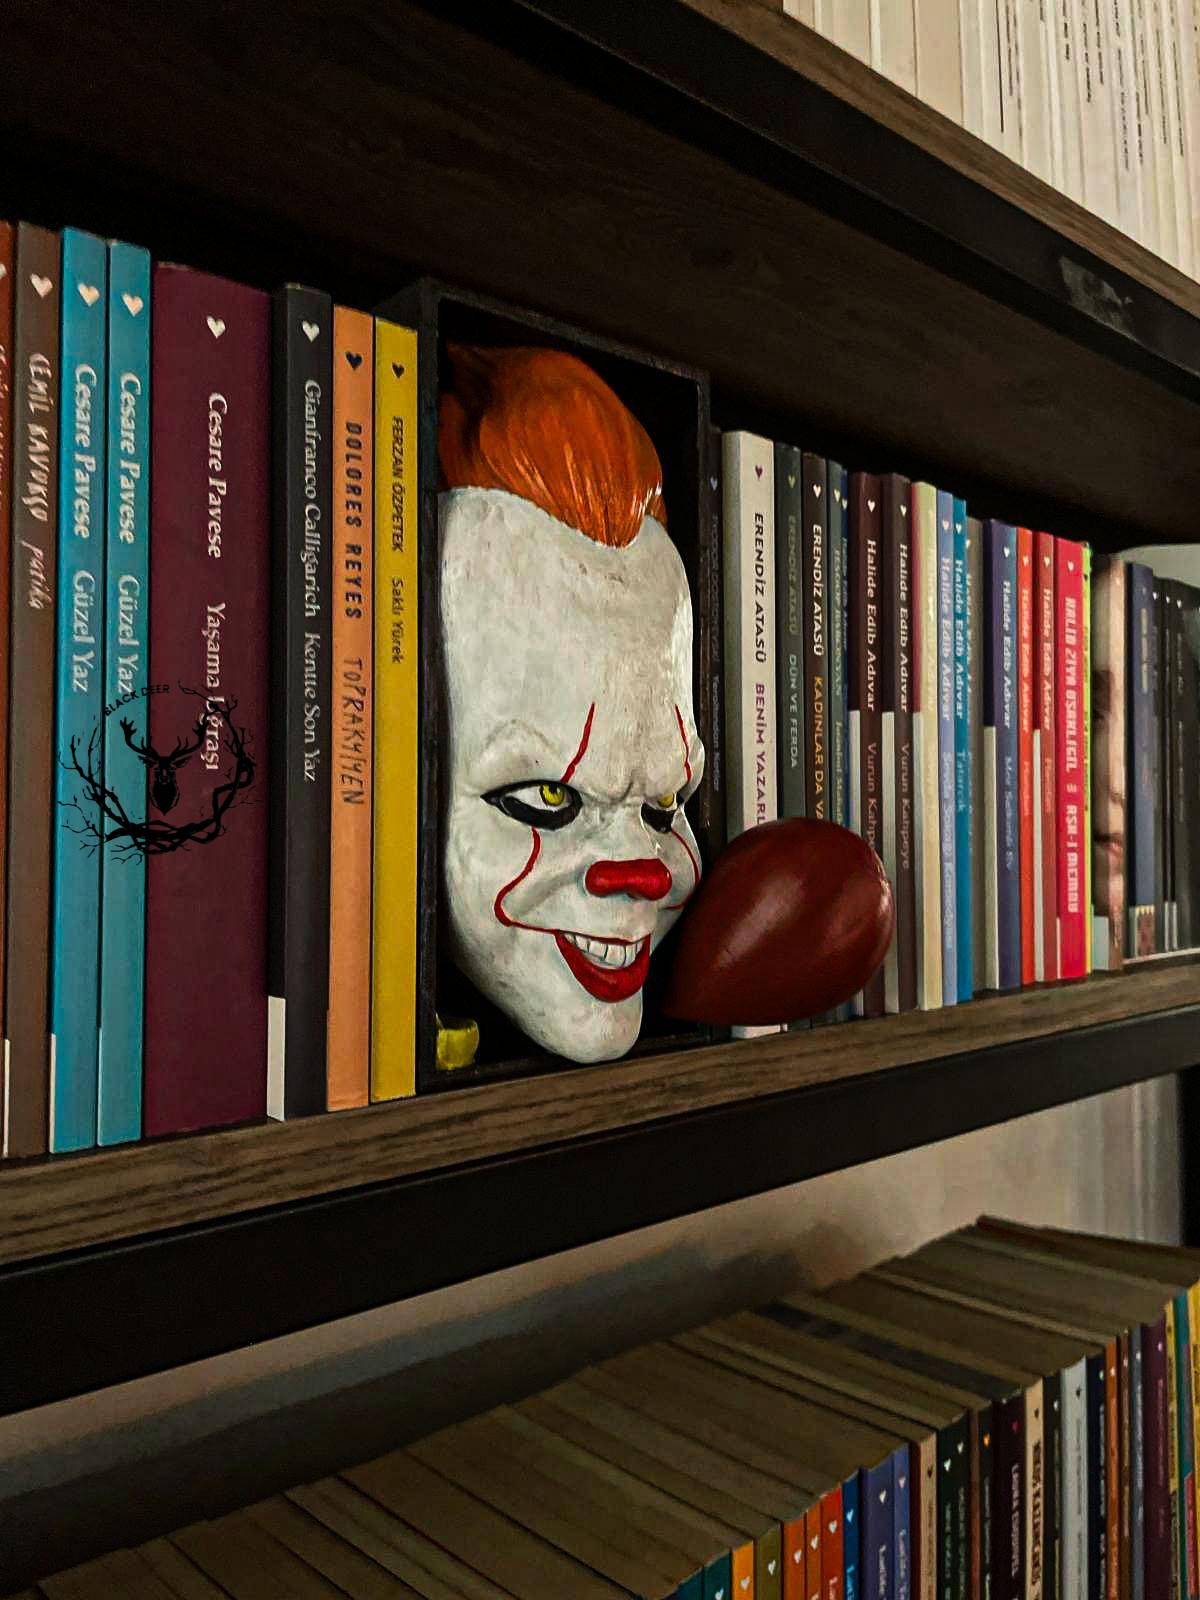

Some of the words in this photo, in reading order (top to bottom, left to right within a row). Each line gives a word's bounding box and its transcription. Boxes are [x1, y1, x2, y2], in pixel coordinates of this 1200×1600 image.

[27, 353, 55, 417] CEMİL
[74, 364, 98, 447] Cesare
[119, 372, 142, 454] Cesare
[207, 392, 229, 471] Cesare
[302, 379, 322, 499] Gianfranco
[392, 416, 405, 477] FERZAN
[20, 423, 52, 523] KAVUKÇU
[74, 452, 98, 539] Pavese
[119, 459, 142, 545] Pavese
[345, 421, 363, 527] DOLORES
[207, 475, 228, 559] Pavese
[392, 482, 406, 553] ÖZPETEK
[19, 539, 53, 610] patika
[300, 502, 322, 617] Calligarich
[345, 543, 363, 619] REYES
[754, 512, 766, 597] ERENDİZ
[812, 524, 825, 599] ERENDİZ
[867, 539, 877, 599] Halide
[899, 543, 909, 602] Halide
[72, 569, 96, 643] Güzel
[117, 574, 141, 646] Güzel
[391, 577, 404, 616] Saklı
[942, 558, 951, 615] Halide
[955, 559, 964, 614] Halide
[1003, 580, 1012, 633] Halide
[1022, 587, 1030, 639] Halide
[1043, 587, 1052, 638] Halide
[201, 602, 227, 688] Yaşama
[391, 621, 404, 664] Yürek
[754, 602, 767, 663] ATASÜ
[812, 602, 825, 657] ATASÜ
[867, 603, 877, 646] Edib
[899, 606, 909, 648] Edib
[942, 618, 952, 658] Edib
[955, 618, 964, 657] Edib
[1003, 635, 1012, 672] Edib
[72, 649, 95, 694] Yaz
[117, 652, 141, 695] Yaz
[303, 631, 321, 699] Kentte
[788, 654, 799, 689] DÜN
[867, 649, 877, 712] Adıvar
[900, 651, 909, 713] Adıvar
[1022, 642, 1030, 679] Edib
[1043, 641, 1052, 677] Edib
[755, 683, 768, 745] BENİM
[789, 692, 798, 713] VE
[942, 663, 951, 721] Adıvar
[955, 661, 964, 720] Adıvar
[1003, 675, 1012, 729] Adıvar
[1022, 681, 1030, 734] Adıvar
[1043, 679, 1052, 731] Adıvar
[303, 702, 321, 744] Son
[789, 718, 799, 769] FERDA
[813, 675, 825, 766] KADINLAR
[303, 748, 321, 783] Yaz
[756, 751, 767, 827] YAZARL
[814, 769, 824, 795] DA
[867, 742, 877, 793] Vurun
[901, 742, 910, 793] Vurun
[815, 799, 824, 820] VA
[900, 798, 910, 870] Kahpeye
